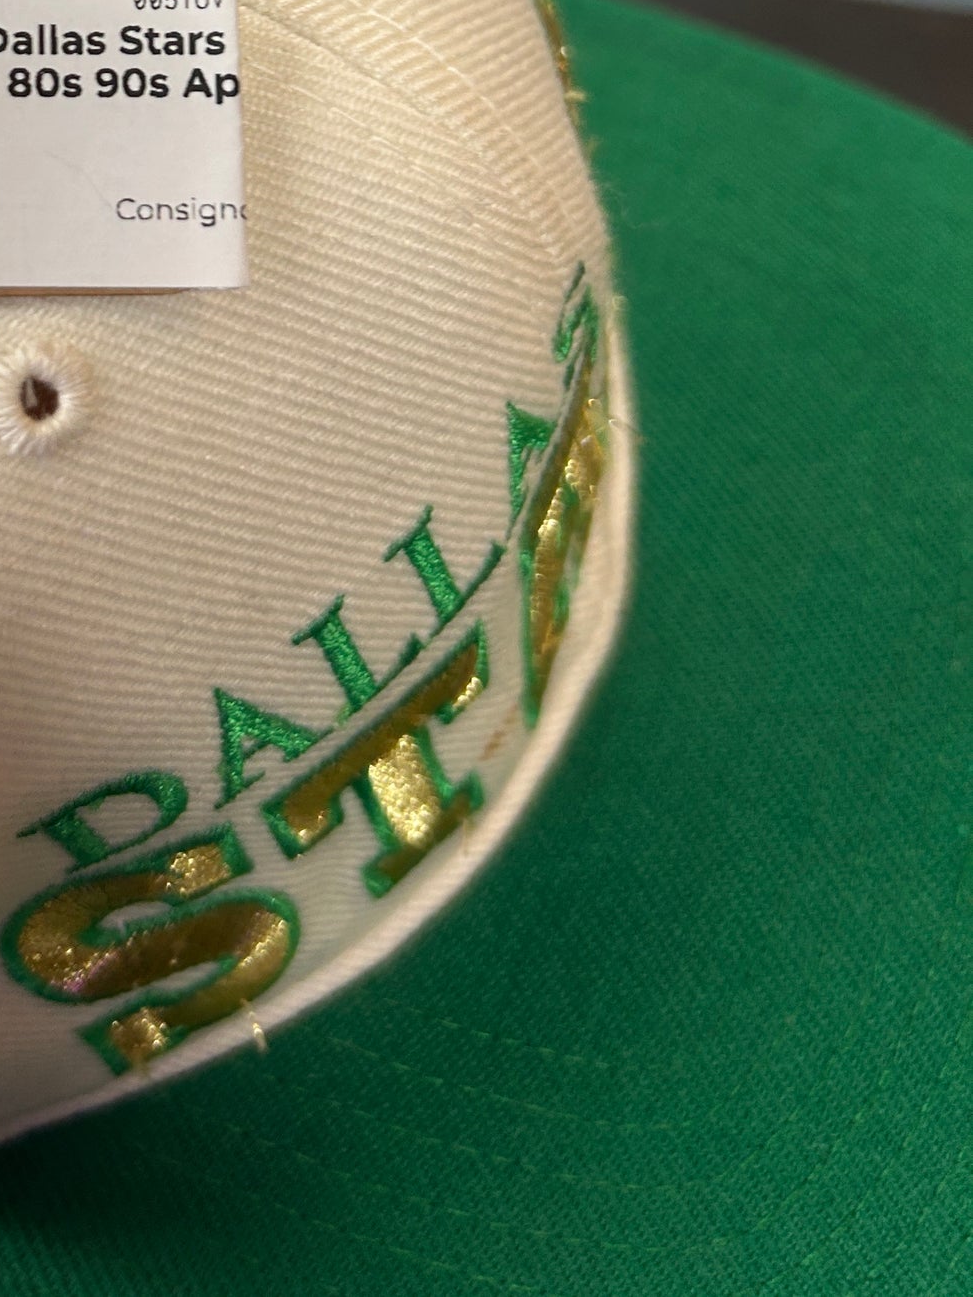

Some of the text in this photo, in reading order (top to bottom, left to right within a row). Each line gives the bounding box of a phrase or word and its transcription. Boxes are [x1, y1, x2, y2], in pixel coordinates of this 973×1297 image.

[118, 24, 226, 56] Stars
[7, 67, 84, 99] 80s
[94, 67, 171, 99] 90s
[182, 67, 240, 105] Ap
